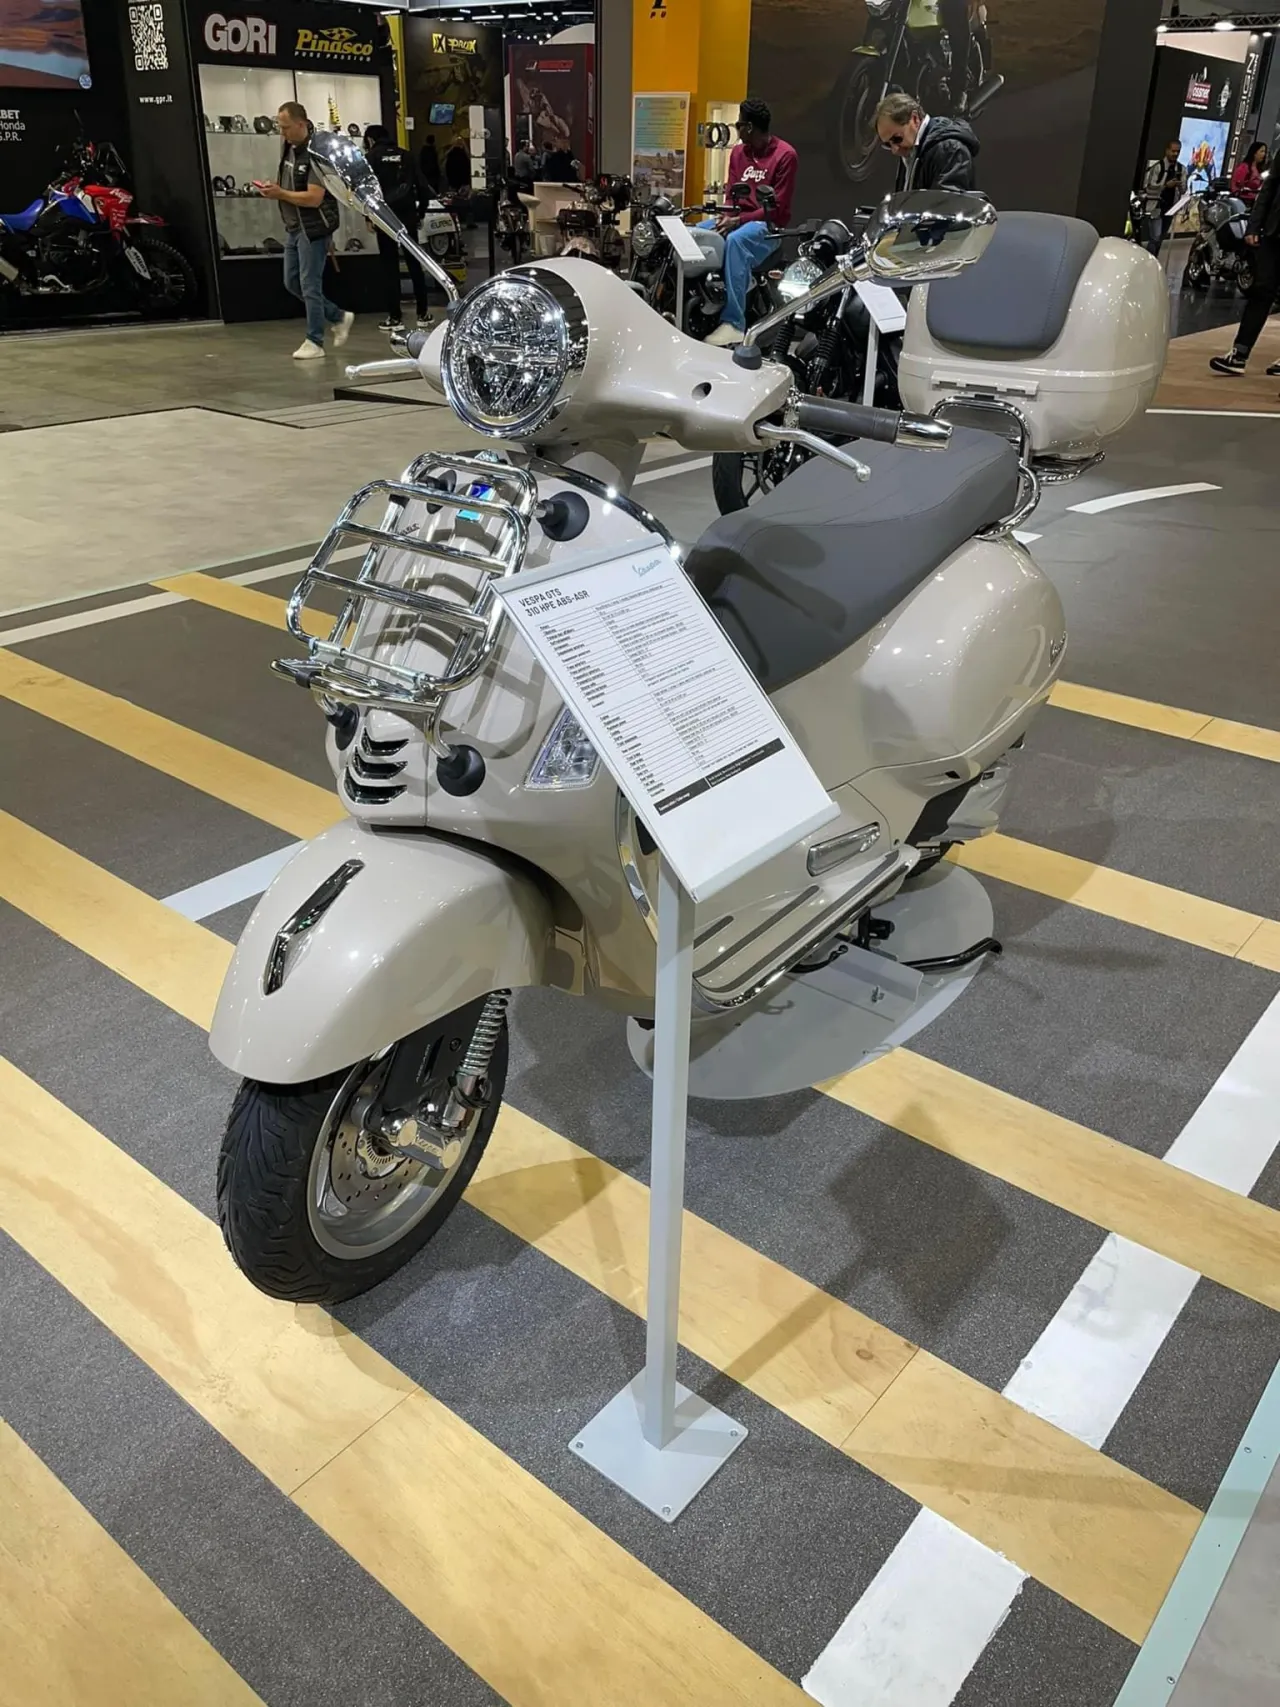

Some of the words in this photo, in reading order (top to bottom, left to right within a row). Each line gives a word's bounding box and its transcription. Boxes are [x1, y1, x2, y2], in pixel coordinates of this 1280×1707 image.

[295, 29, 373, 56] Pinasco
[139, 94, 173, 105] www.gpr.it
[0, 109, 20, 119] BET
[632, 559, 662, 577] Vespa
[518, 593, 547, 607] VESPA
[546, 588, 562, 600] GTS
[525, 607, 539, 617] 310
[539, 600, 558, 613] HPE
[557, 590, 590, 609] ABS-ASR
